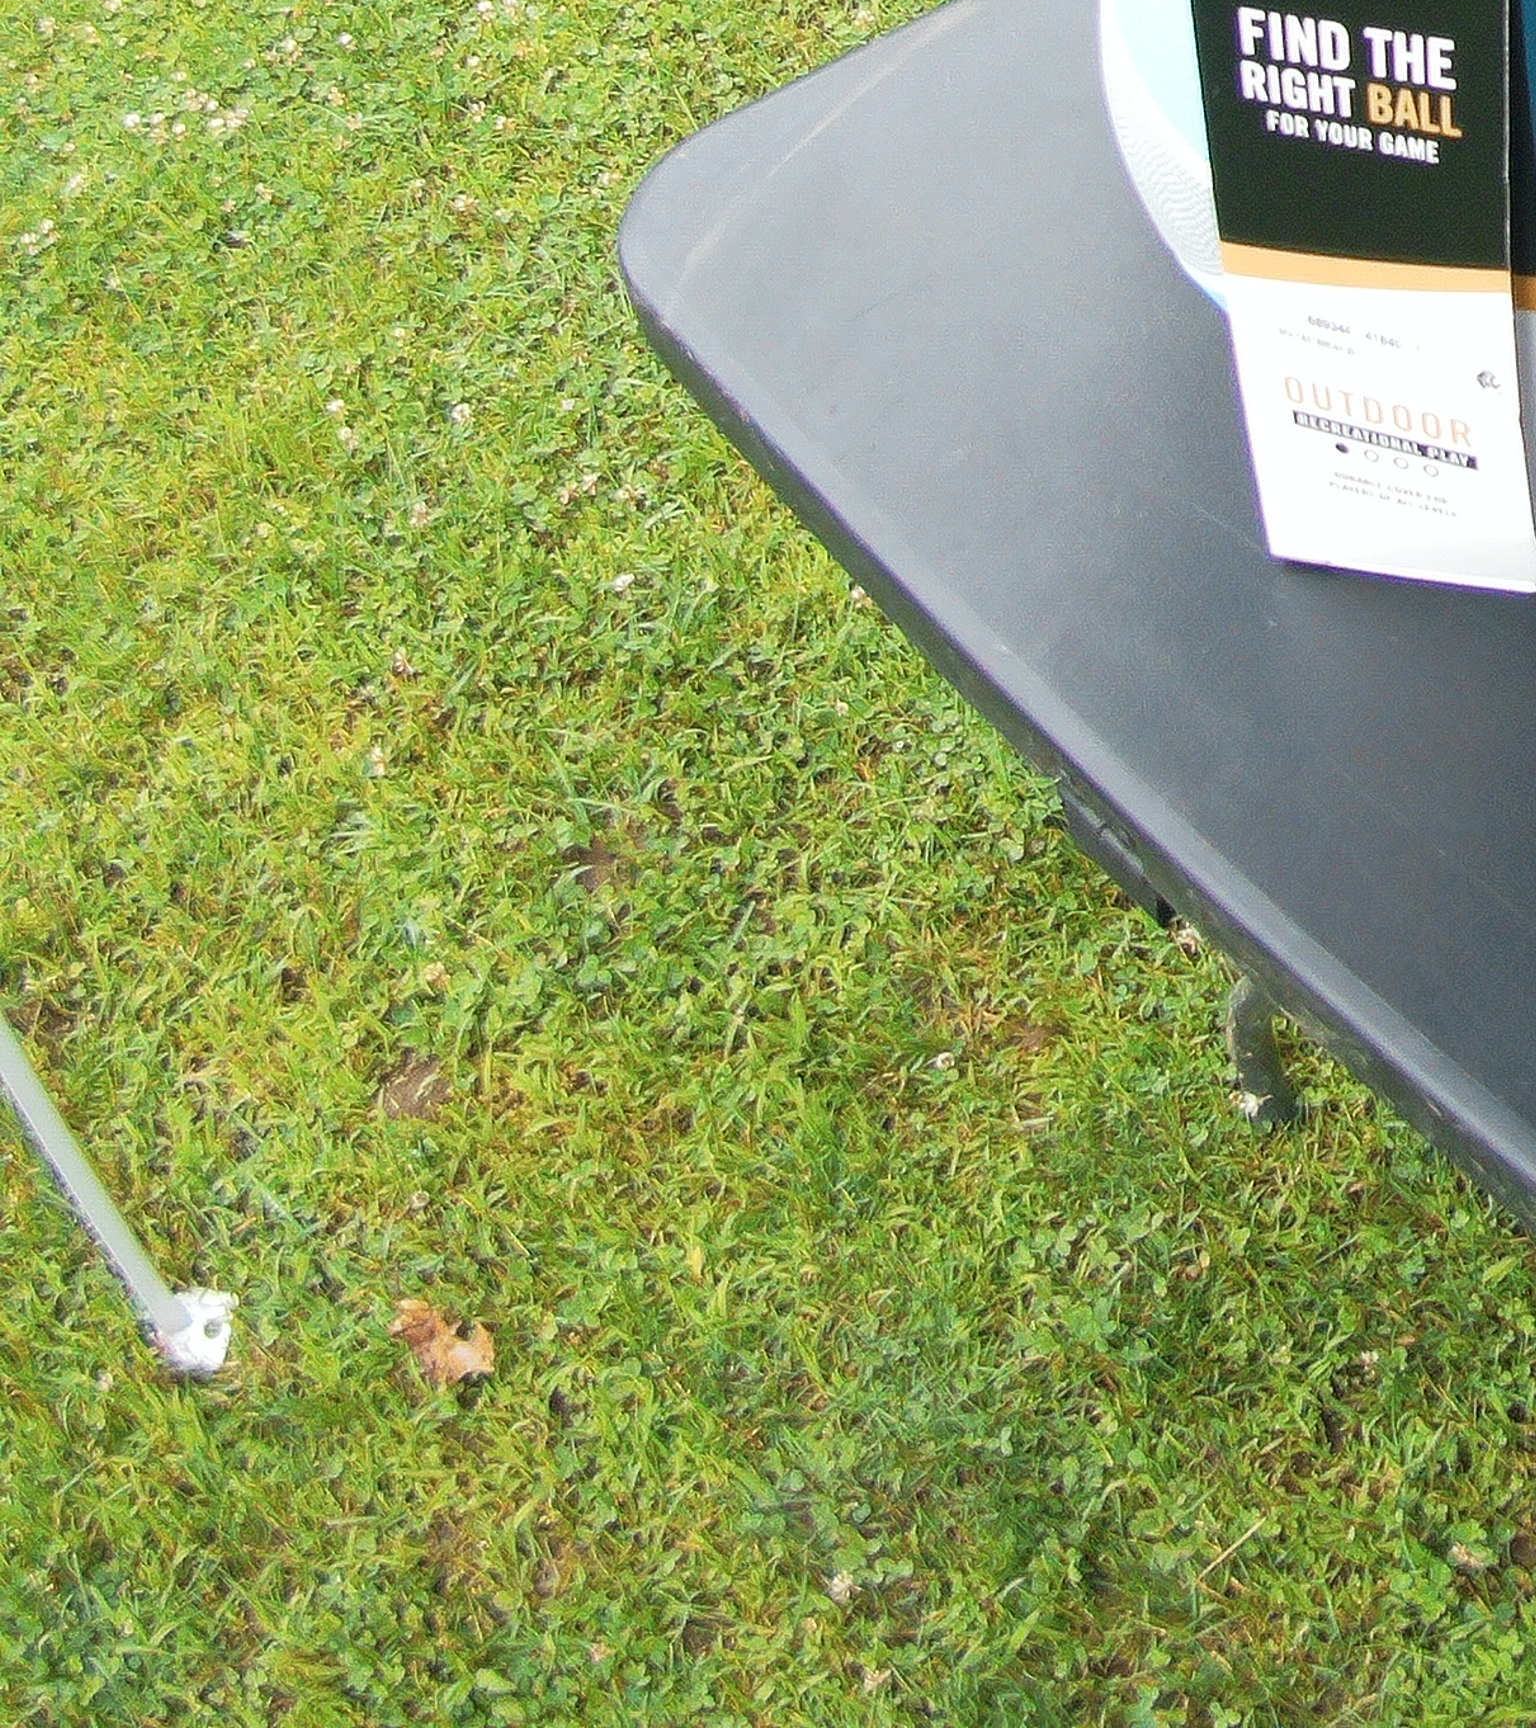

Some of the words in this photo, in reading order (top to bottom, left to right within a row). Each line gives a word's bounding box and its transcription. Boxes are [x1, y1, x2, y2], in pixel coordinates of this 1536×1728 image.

[1235, 5, 1352, 73] FIND
[1362, 25, 1458, 92] THE
[1240, 59, 1356, 119] RIGHT
[1366, 81, 1463, 139] BALL
[1265, 109, 1310, 140] FOR
[1315, 117, 1374, 151] YOUR
[1378, 129, 1440, 166] GAME
[1283, 375, 1473, 449] OUTDOOR
[1296, 411, 1422, 457] RECREATIONAL
[1425, 445, 1472, 469] PLAY
